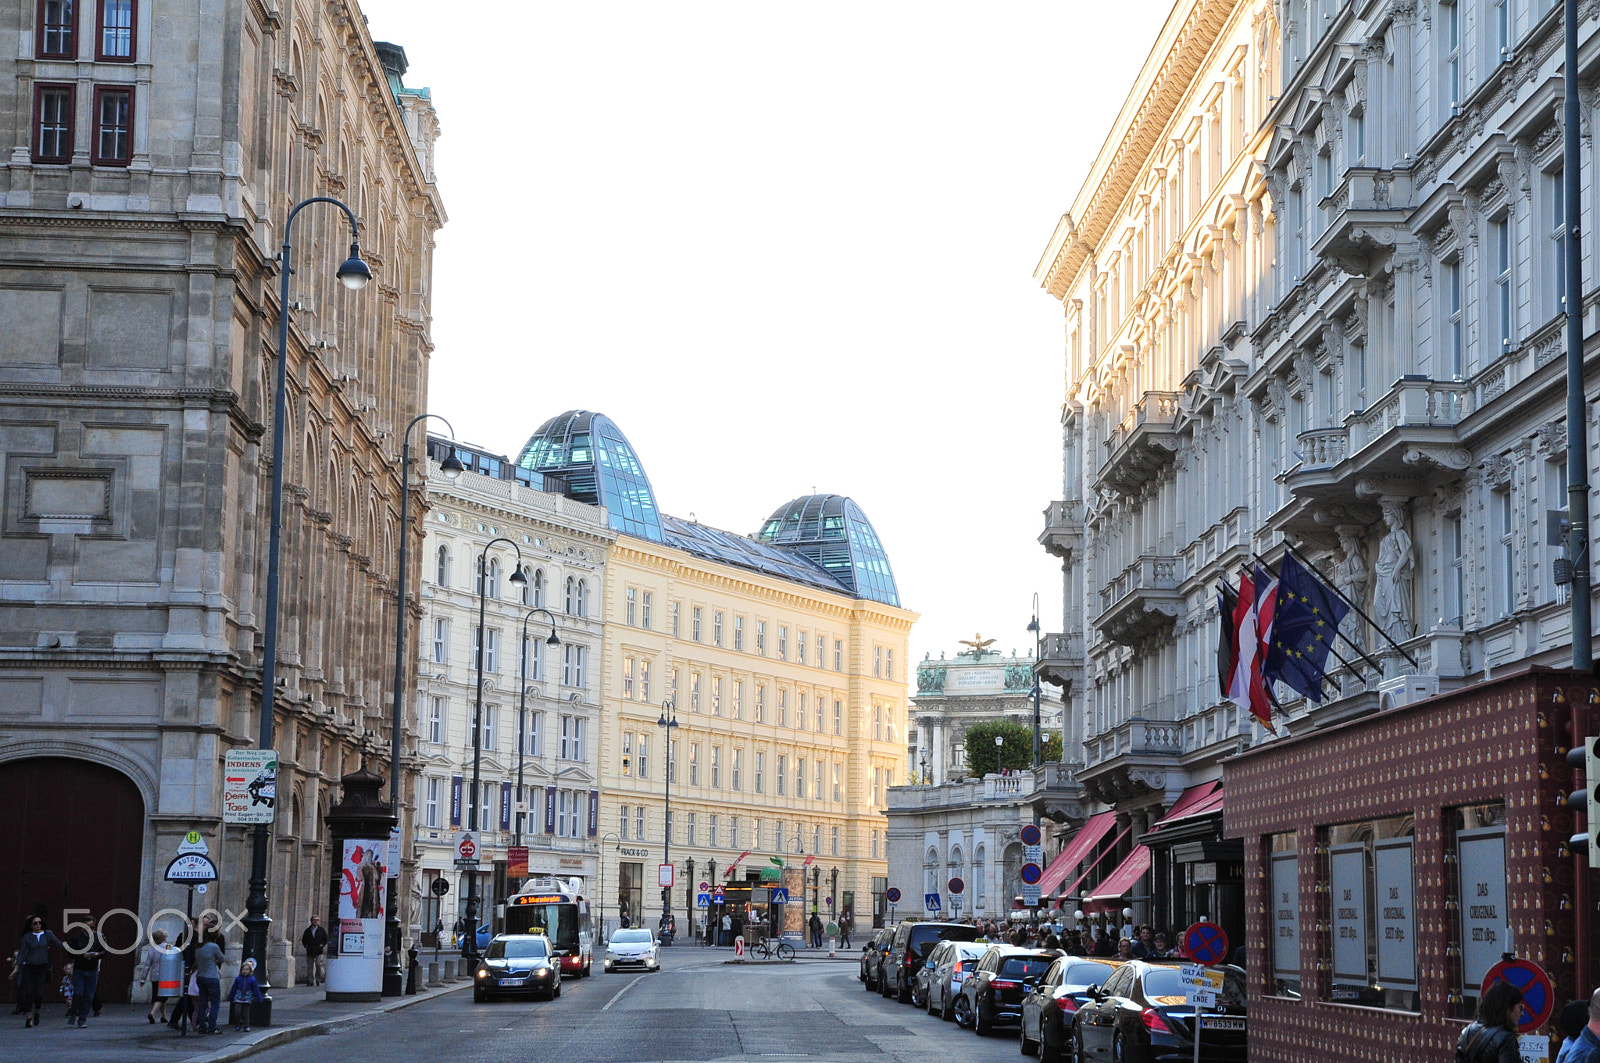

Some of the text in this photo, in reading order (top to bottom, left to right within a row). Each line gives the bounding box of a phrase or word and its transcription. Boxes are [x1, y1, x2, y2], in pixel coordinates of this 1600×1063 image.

[190, 833, 197, 841] H
[178, 856, 207, 866] AUTOBUS
[1389, 887, 1398, 899] DAS
[1477, 883, 1488, 896] DAS
[1193, 995, 1208, 1003] ENDE
